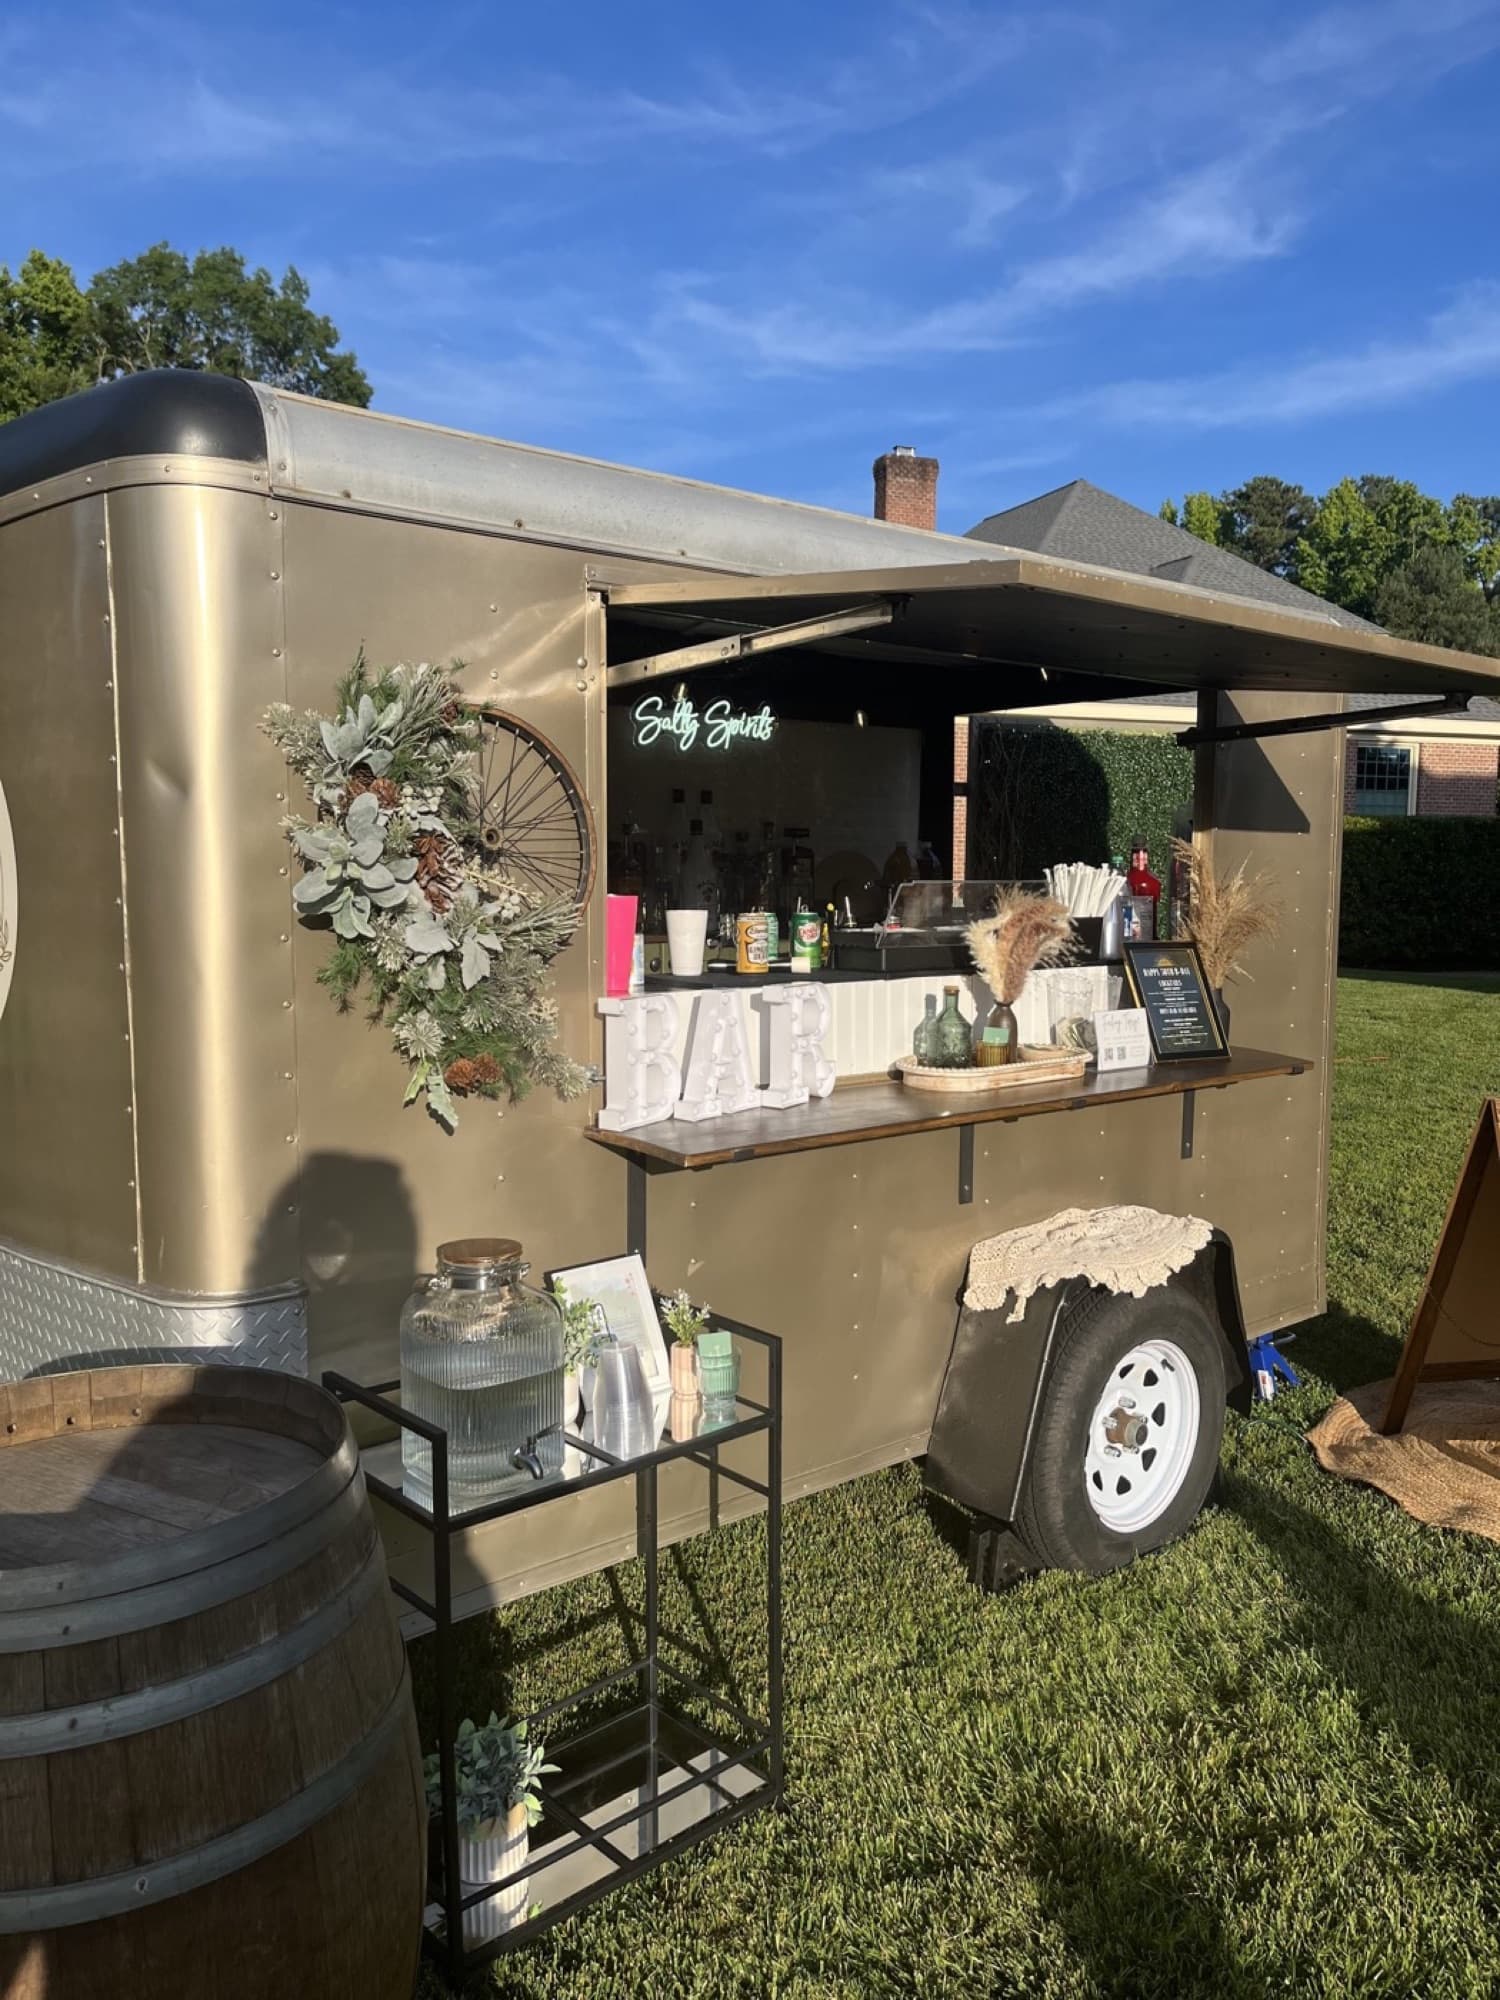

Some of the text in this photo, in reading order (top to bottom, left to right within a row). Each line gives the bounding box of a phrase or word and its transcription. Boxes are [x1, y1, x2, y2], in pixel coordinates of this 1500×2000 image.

[635, 697, 775, 750] Salty Spirits
[598, 981, 837, 1132] BAR
